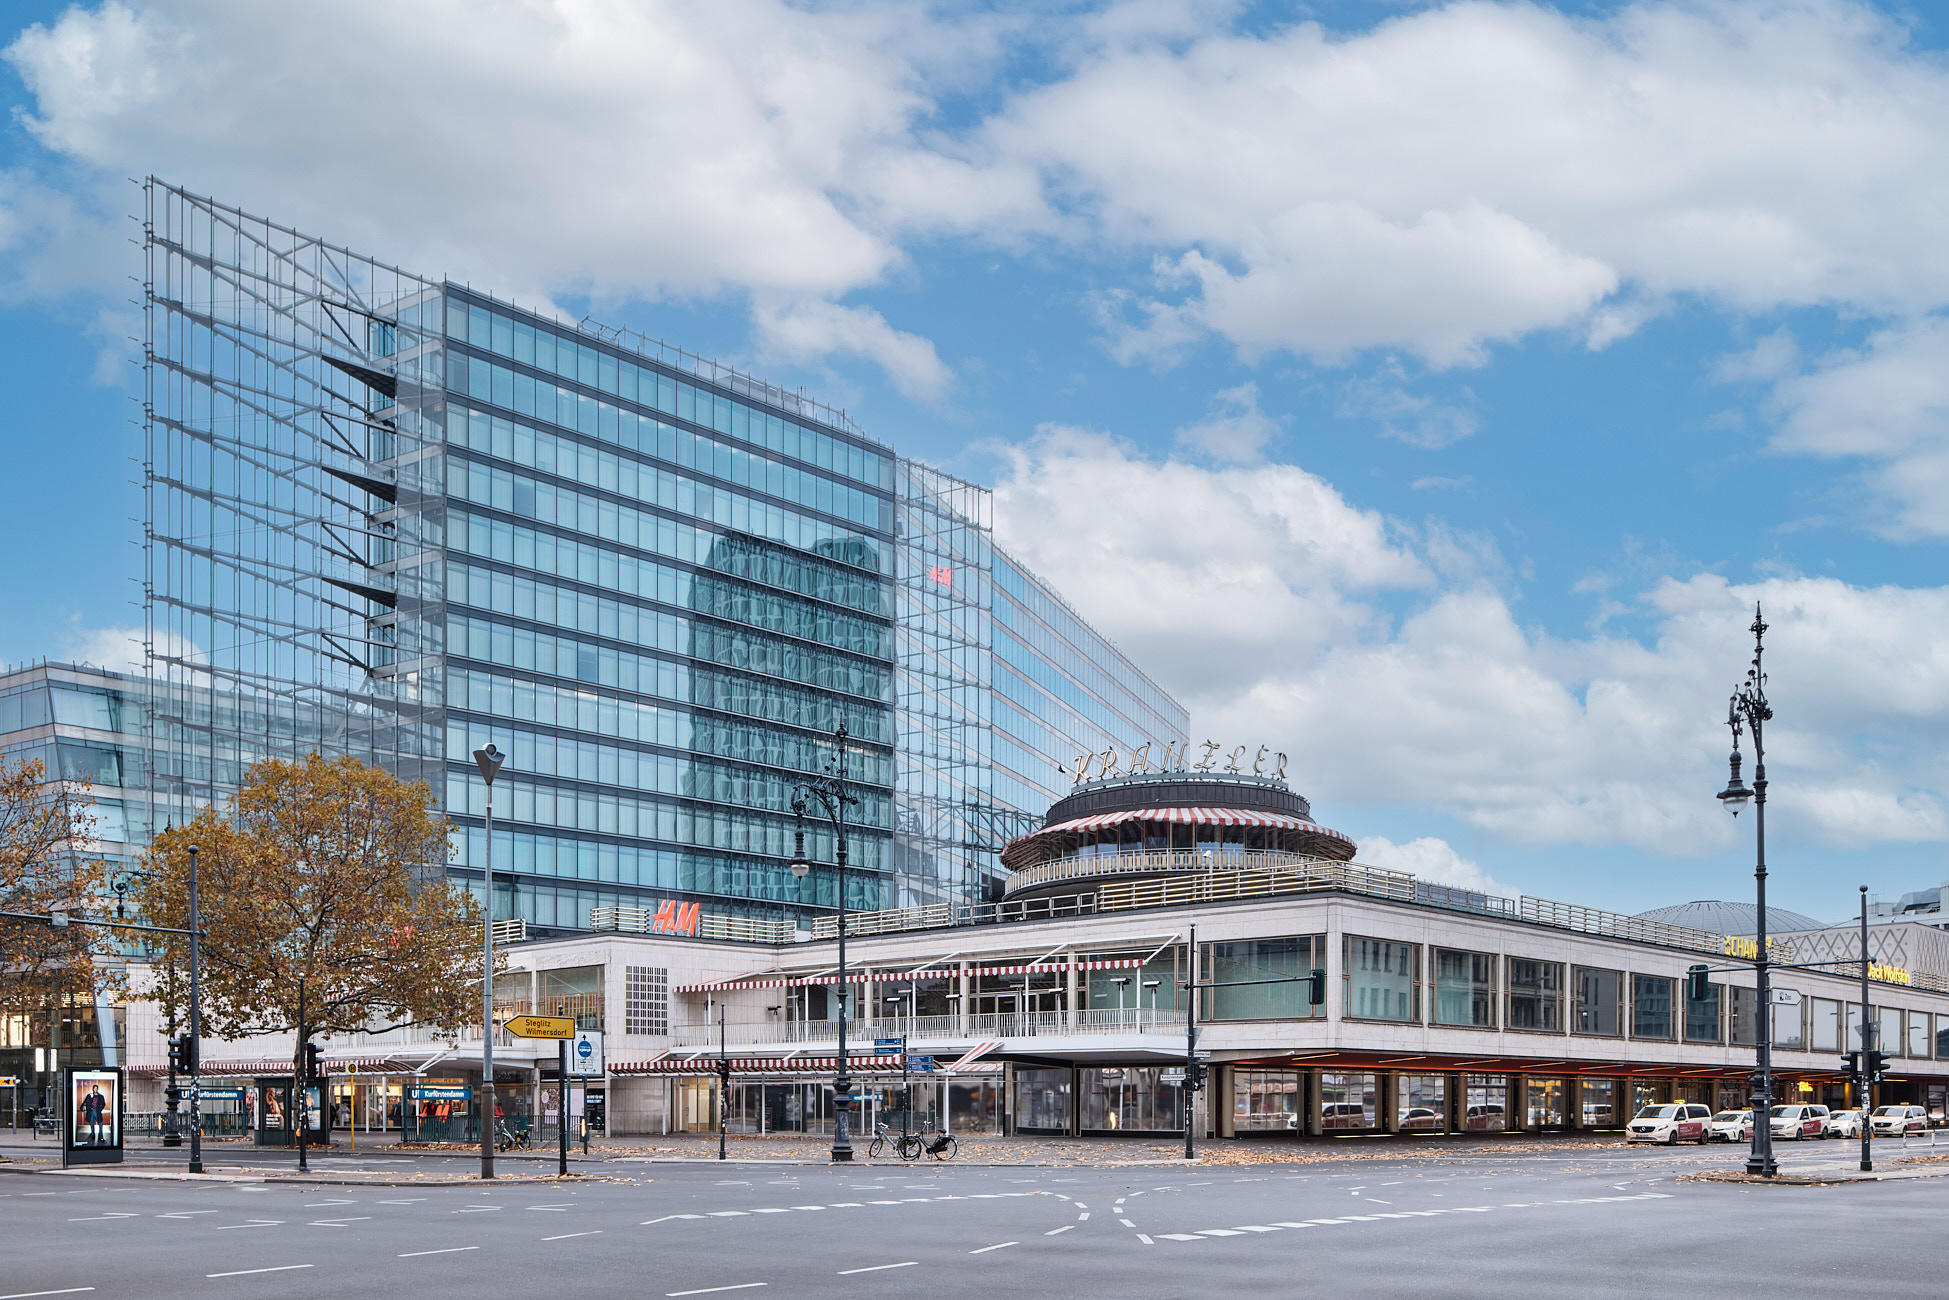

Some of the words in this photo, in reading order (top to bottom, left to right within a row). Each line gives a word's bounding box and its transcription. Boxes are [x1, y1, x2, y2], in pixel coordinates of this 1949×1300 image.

[929, 564, 953, 587] H&M
[1071, 742, 1290, 784] KRANZLER
[652, 899, 700, 936] H&M
[1867, 961, 1883, 980] Jack
[1882, 964, 1910, 984] Wolfskin
[525, 1019, 551, 1028] Steglitz
[525, 1028, 567, 1036] Wilmersdorf
[424, 1090, 464, 1098] Kurfürstendamm
